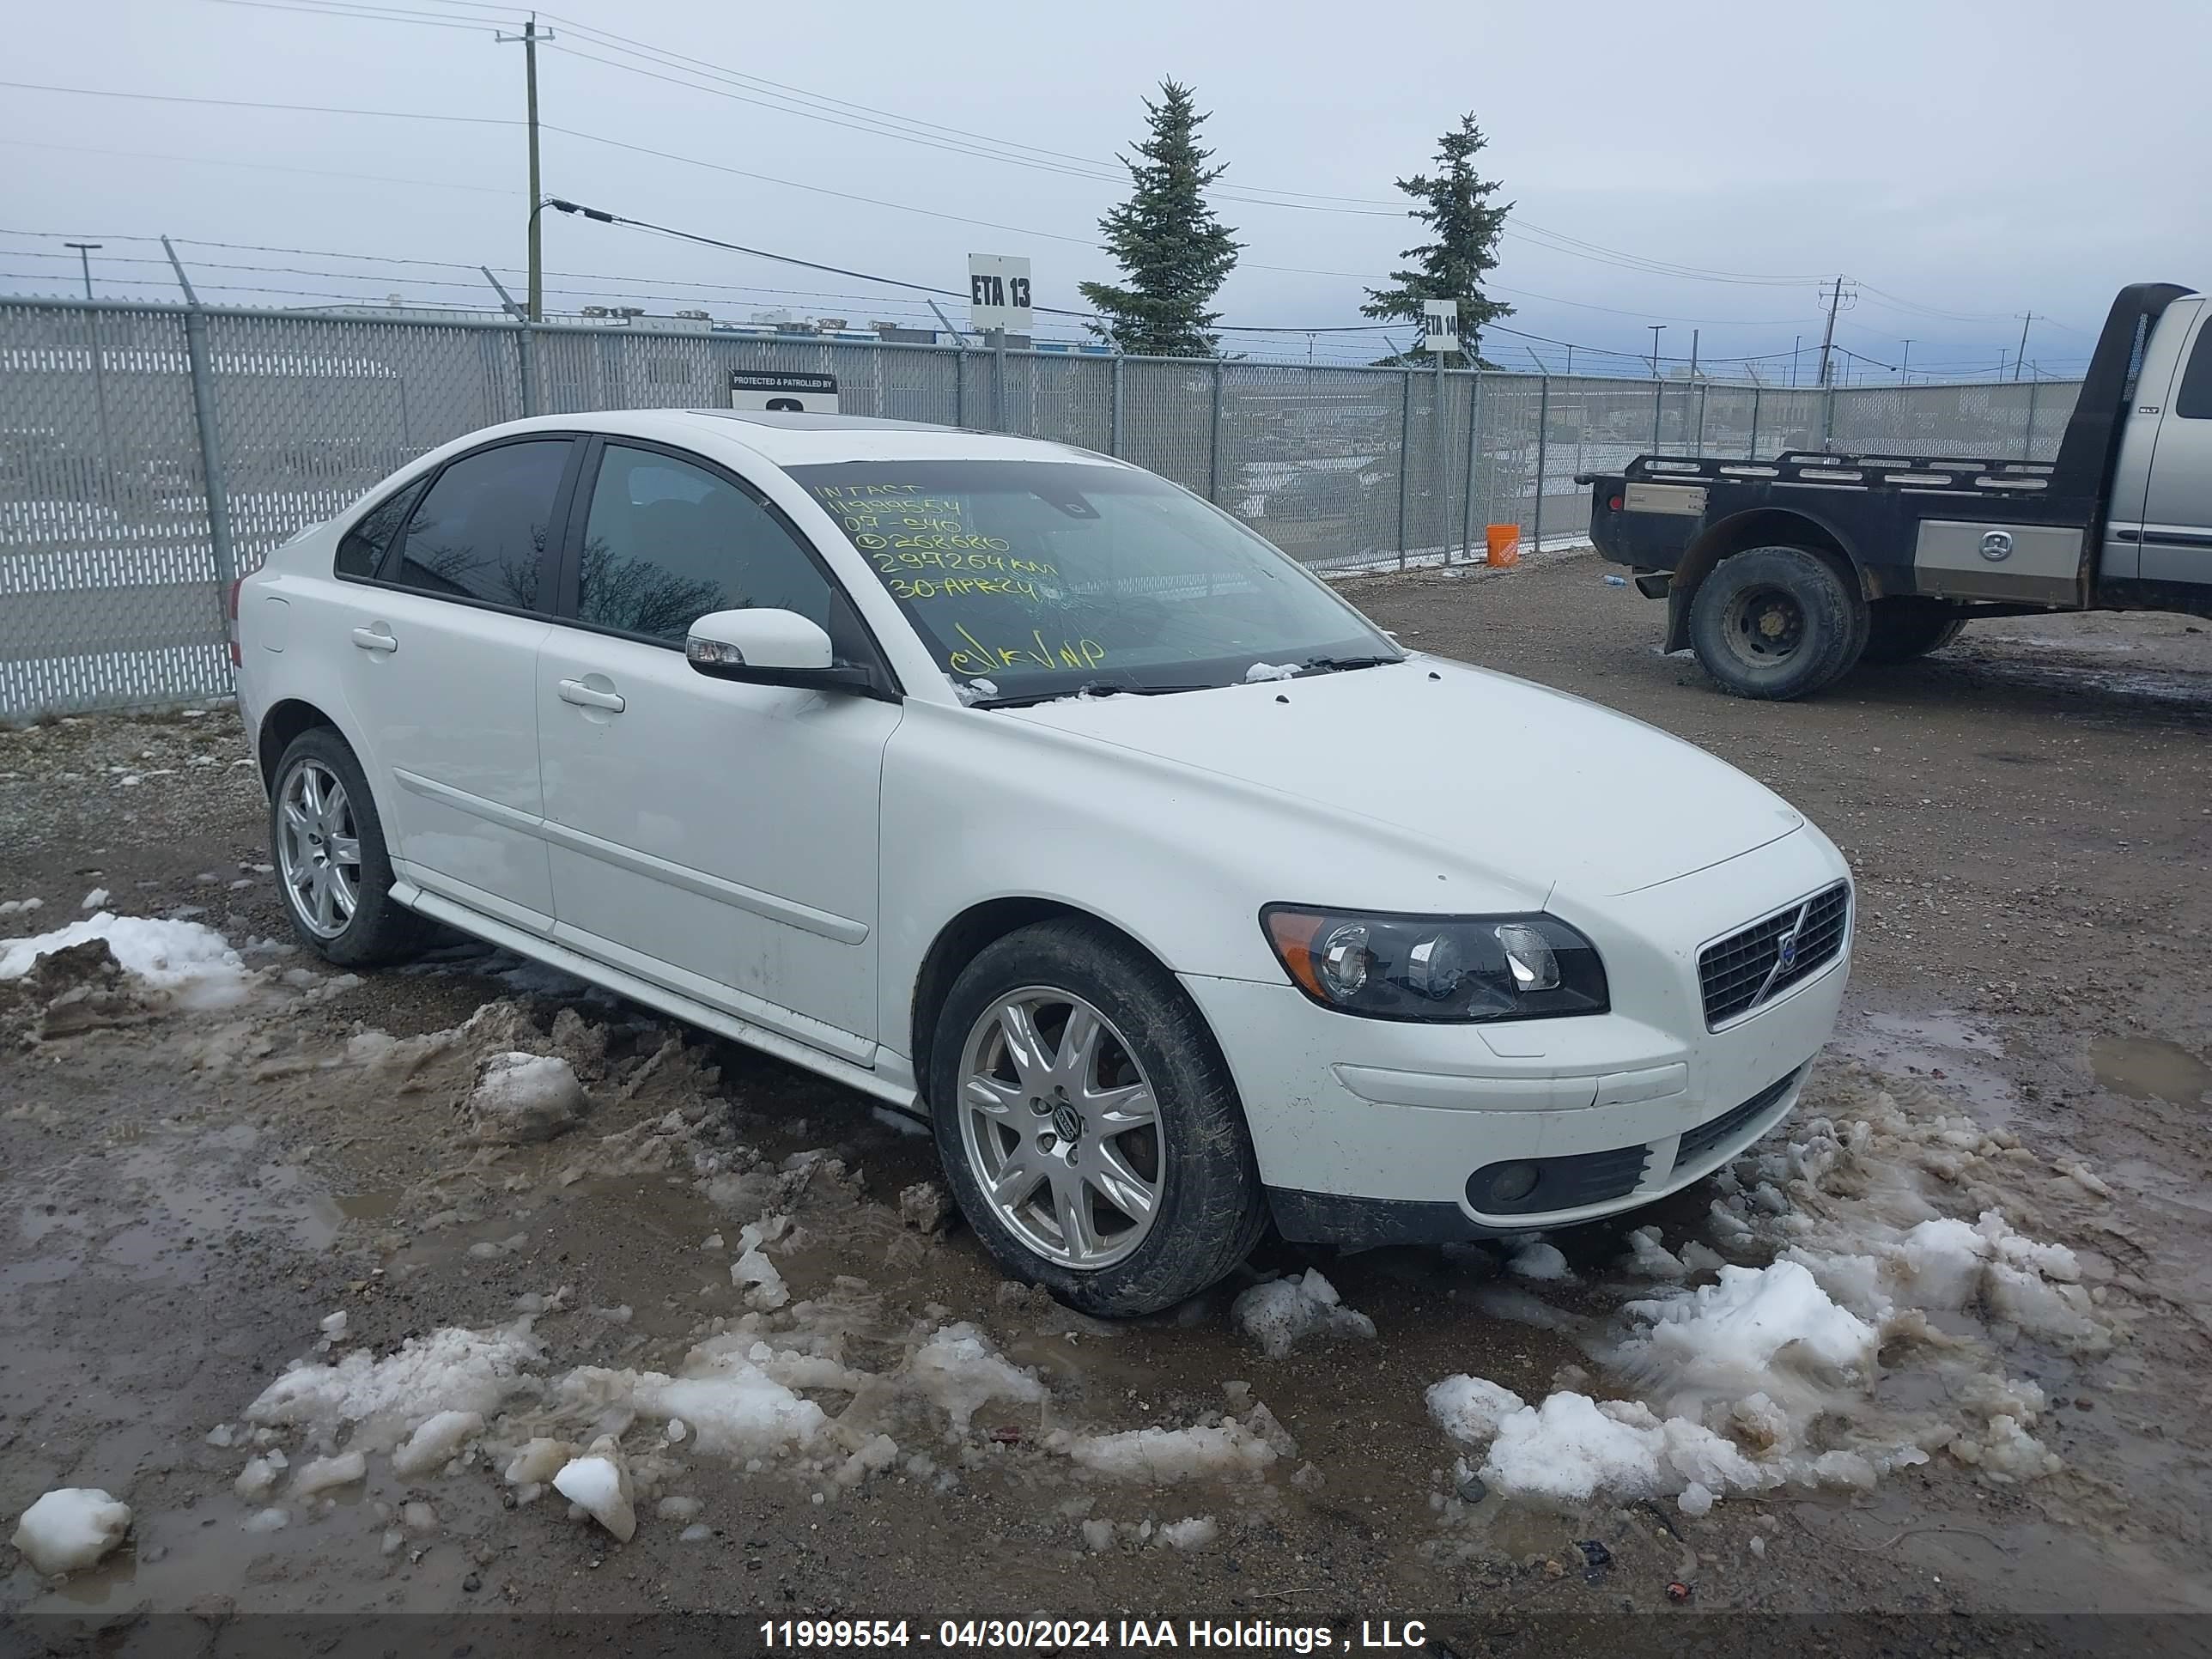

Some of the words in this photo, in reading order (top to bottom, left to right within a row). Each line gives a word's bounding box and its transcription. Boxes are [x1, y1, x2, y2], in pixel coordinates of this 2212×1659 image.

[971, 275, 1005, 307] ETA
[1010, 277, 1030, 308] 13
[1425, 314, 1443, 336] ETA
[1445, 315, 1457, 336] 14
[733, 376, 775, 386] PROTECTED
[782, 378, 822, 387] PATROLLED
[814, 485, 925, 498] INTACT
[827, 499, 961, 515] 11999554
